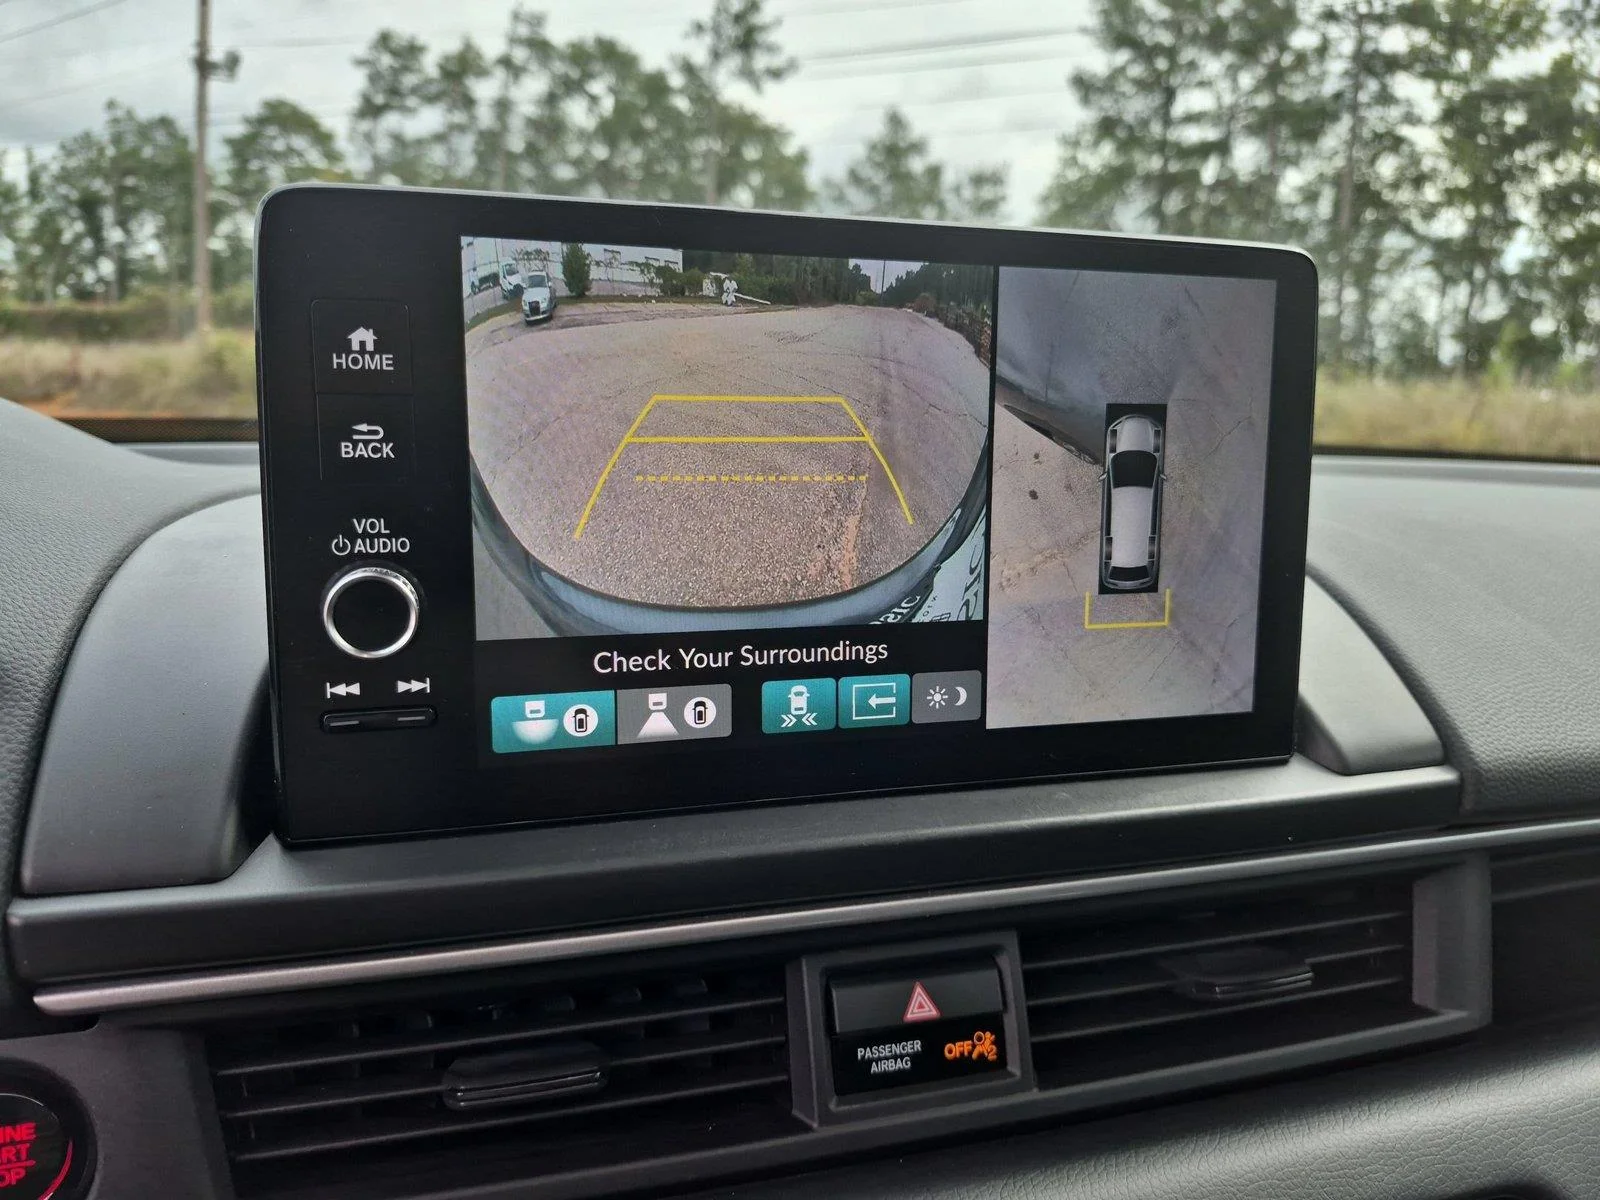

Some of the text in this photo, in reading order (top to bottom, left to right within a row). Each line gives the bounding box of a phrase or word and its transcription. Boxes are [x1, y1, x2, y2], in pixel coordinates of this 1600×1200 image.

[332, 353, 394, 371] HOME
[340, 441, 395, 459] BACK
[353, 518, 391, 534] VOL
[354, 537, 410, 554] AUDIO
[593, 640, 888, 674] Check Your Surroundings
[857, 1039, 922, 1061] PASSENGER
[944, 1040, 972, 1060] OFF
[870, 1056, 911, 1074] AIRBAG
[0, 1143, 30, 1162] RT
